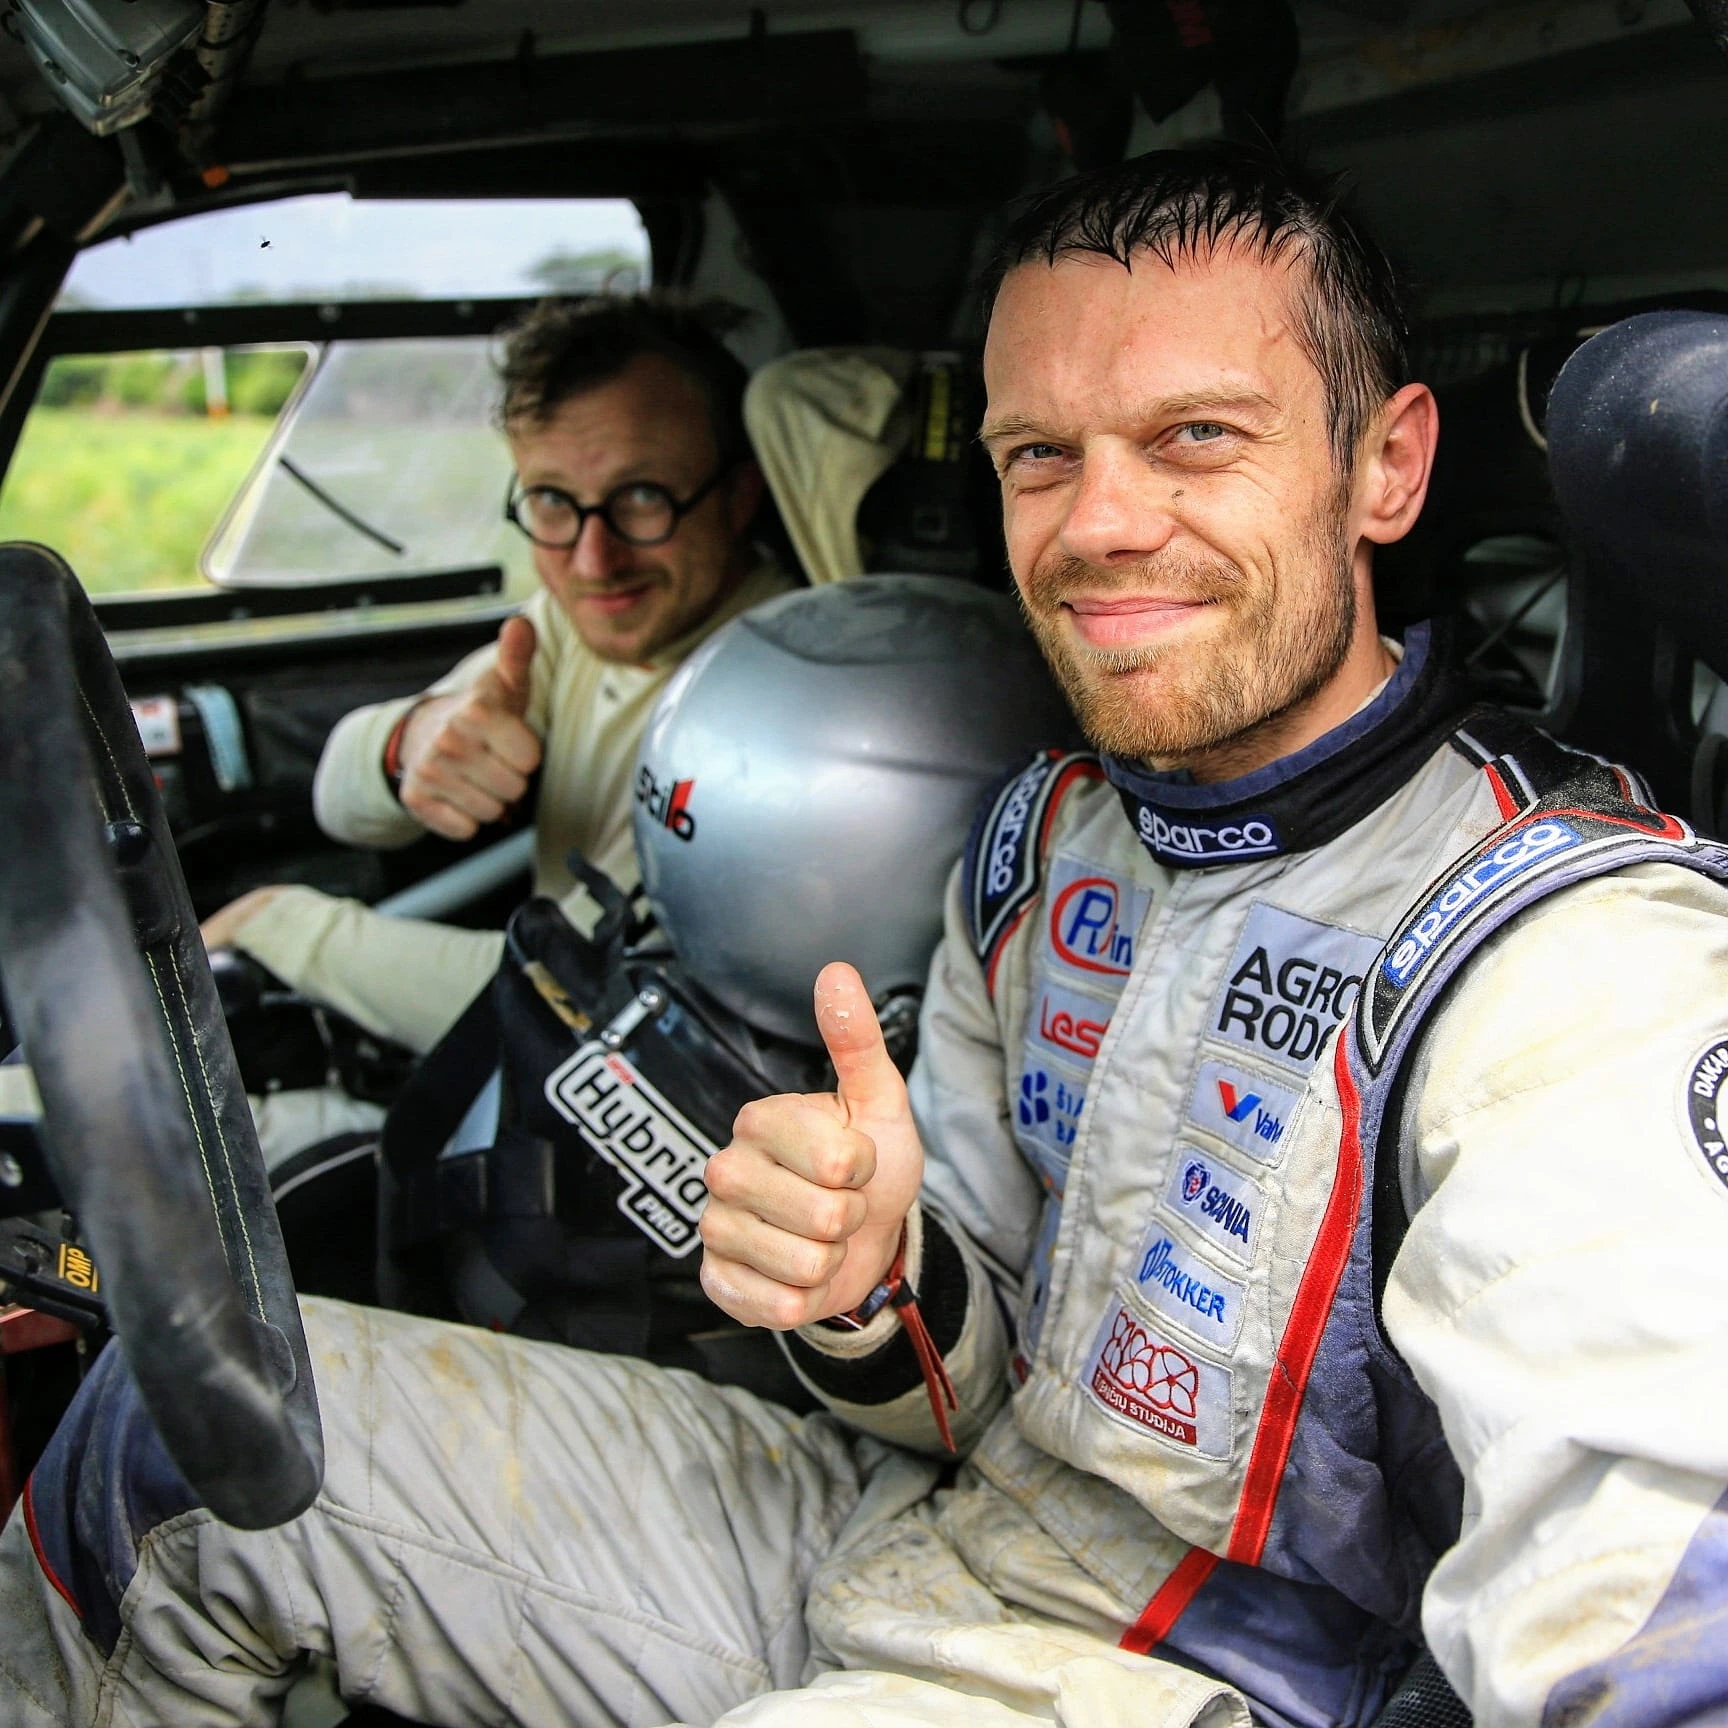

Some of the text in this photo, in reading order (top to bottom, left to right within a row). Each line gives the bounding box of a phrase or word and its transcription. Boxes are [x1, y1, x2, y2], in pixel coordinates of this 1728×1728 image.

[1138, 806, 1273, 853] sparco
[1391, 823, 1566, 972] sparco
[1230, 945, 1363, 1022] AGRO
[1040, 996, 1111, 1060] Les
[634, 1197, 690, 1243] PRO
[1201, 1185, 1252, 1244] SCANIA
[66, 1247, 92, 1288] OMP
[1129, 1402, 1186, 1440] STUDIJA
